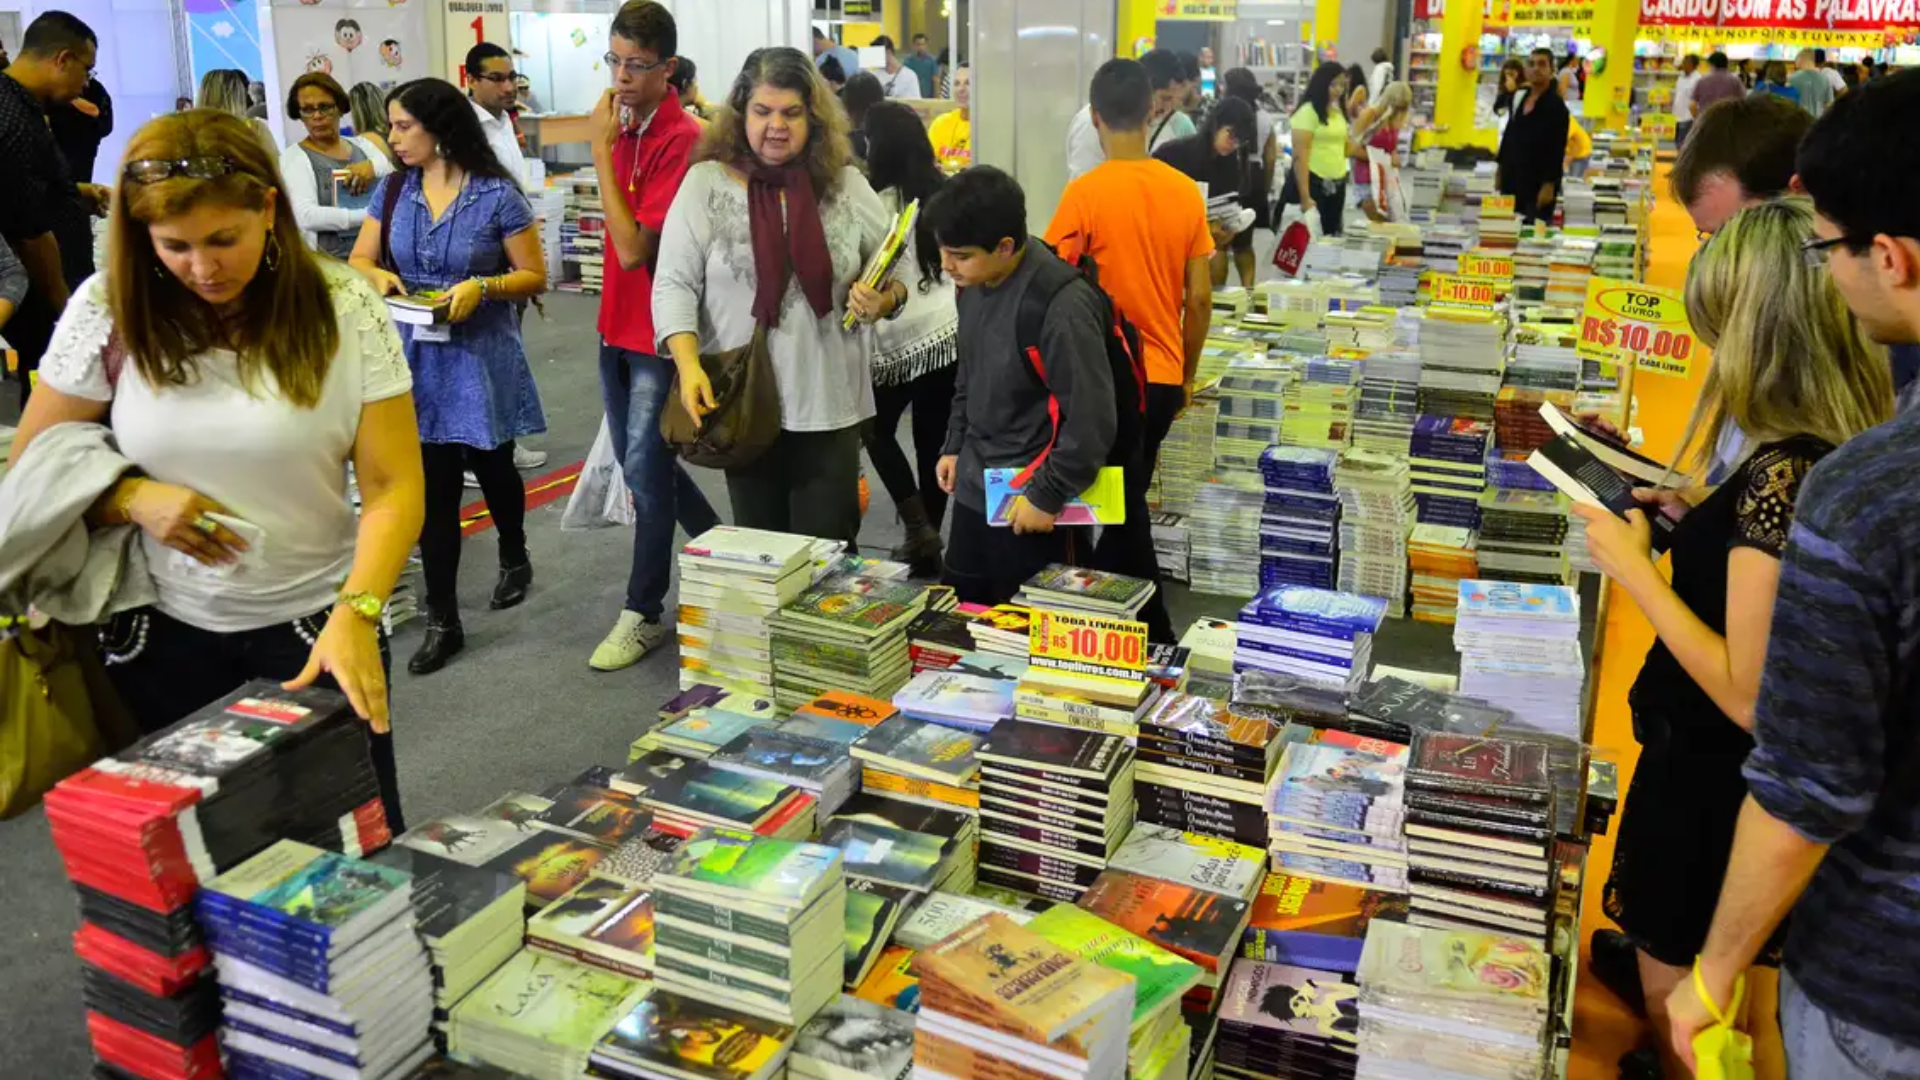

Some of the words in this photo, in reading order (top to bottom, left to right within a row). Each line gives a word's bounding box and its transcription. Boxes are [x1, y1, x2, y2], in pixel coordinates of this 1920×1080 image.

[1723, 0, 1771, 19] COM
[1776, 0, 1807, 20] AS
[1626, 292, 1660, 308] TOP
[1621, 305, 1662, 319] LIVROS
[1054, 615, 1087, 626] TODA
[1088, 620, 1146, 635] LIVRARIA
[1068, 628, 1140, 664] 10,00
